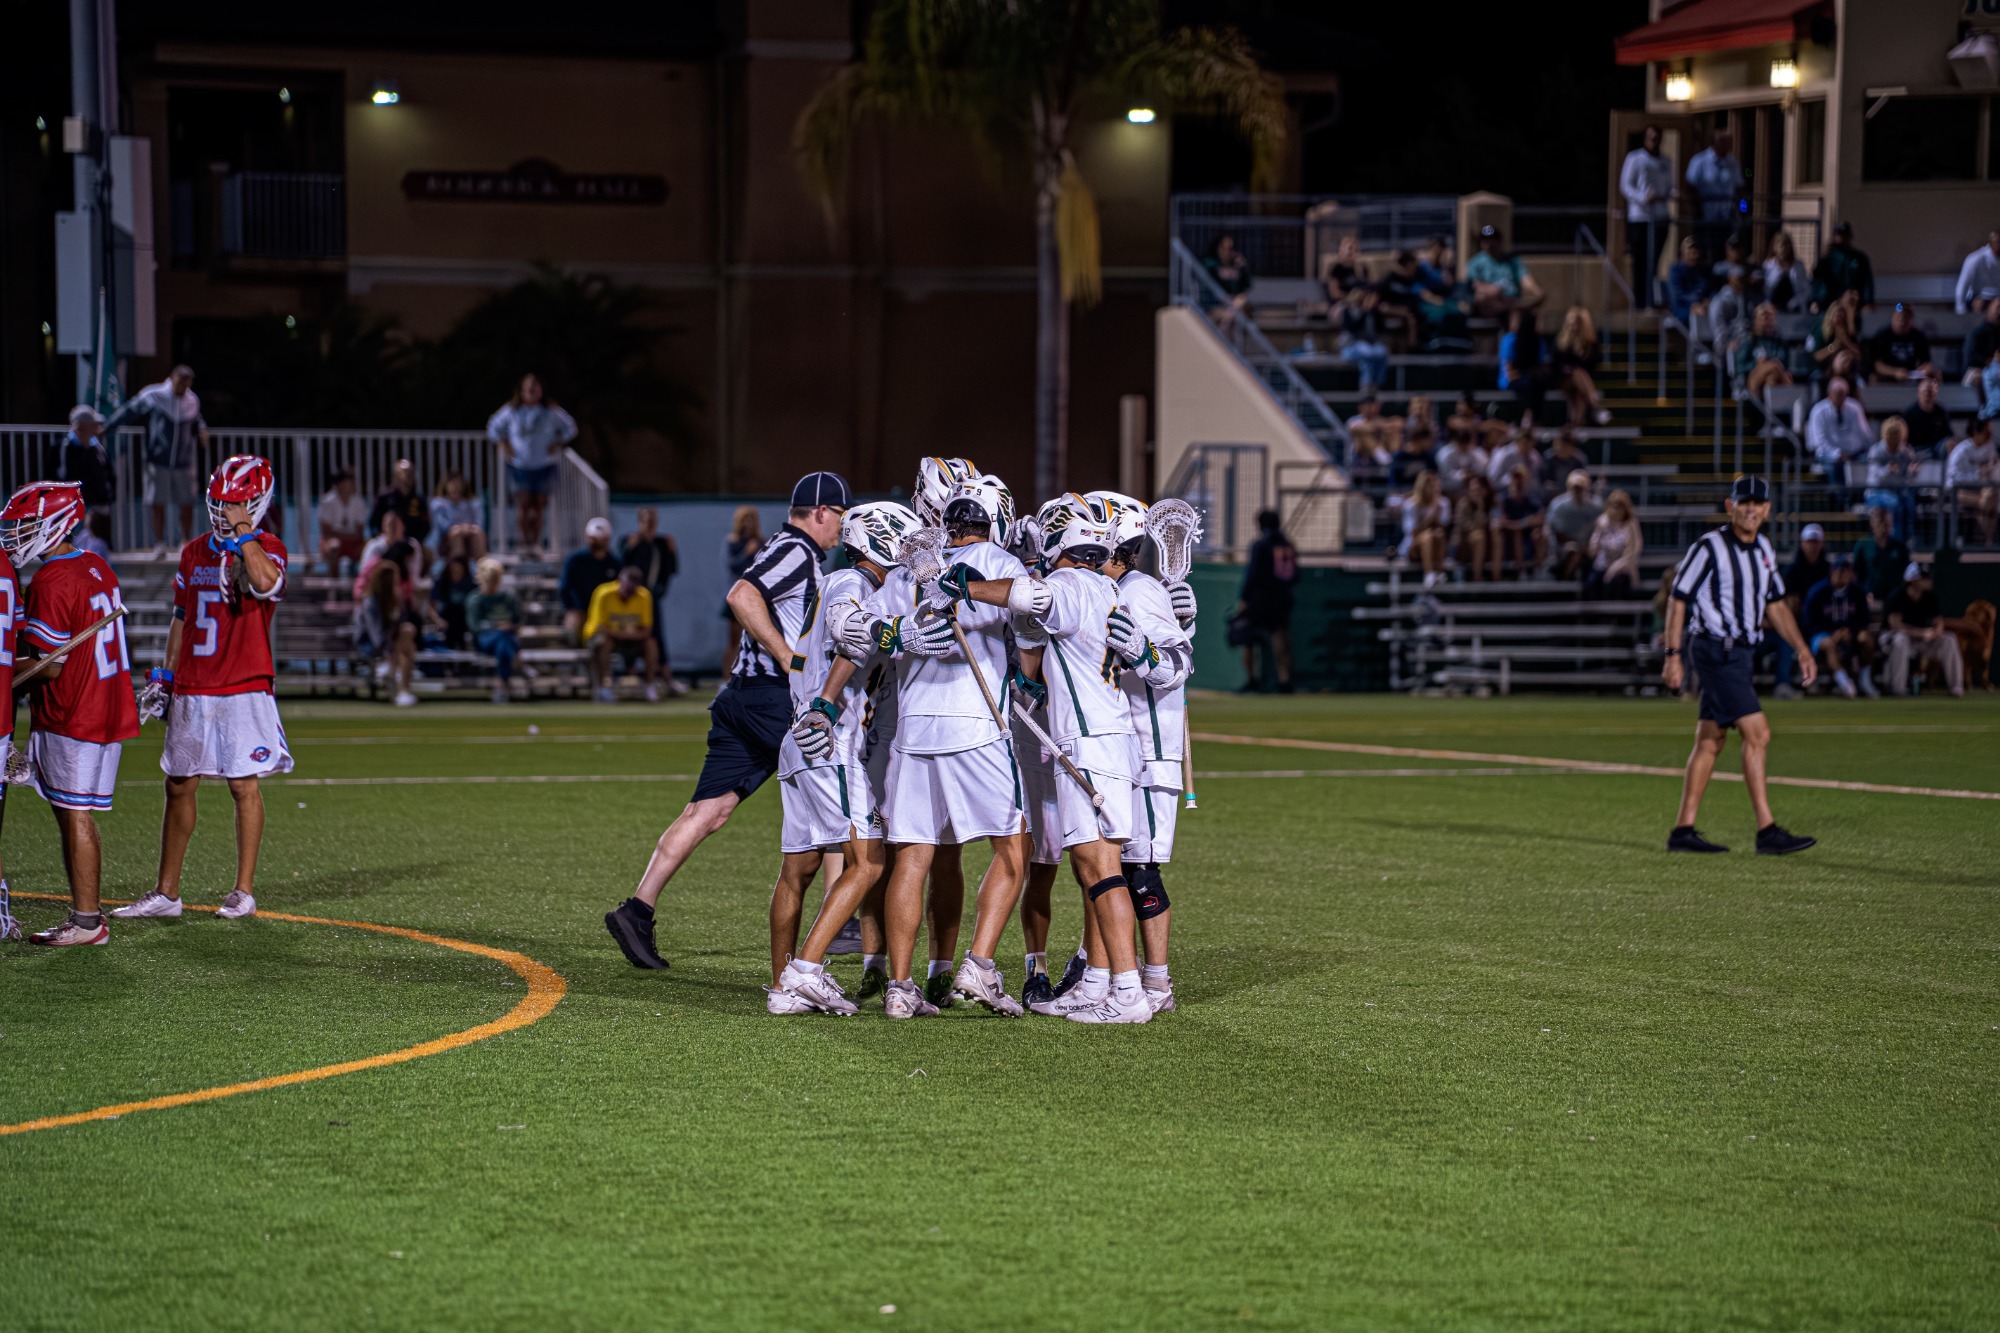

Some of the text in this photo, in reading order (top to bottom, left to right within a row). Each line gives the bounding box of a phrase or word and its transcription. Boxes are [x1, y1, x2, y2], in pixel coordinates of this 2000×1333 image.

[976, 488, 983, 496] 9
[193, 566, 220, 576] FLORI
[193, 590, 221, 656] 5
[89, 586, 131, 681] 21
[1068, 1002, 1095, 1011] balance
